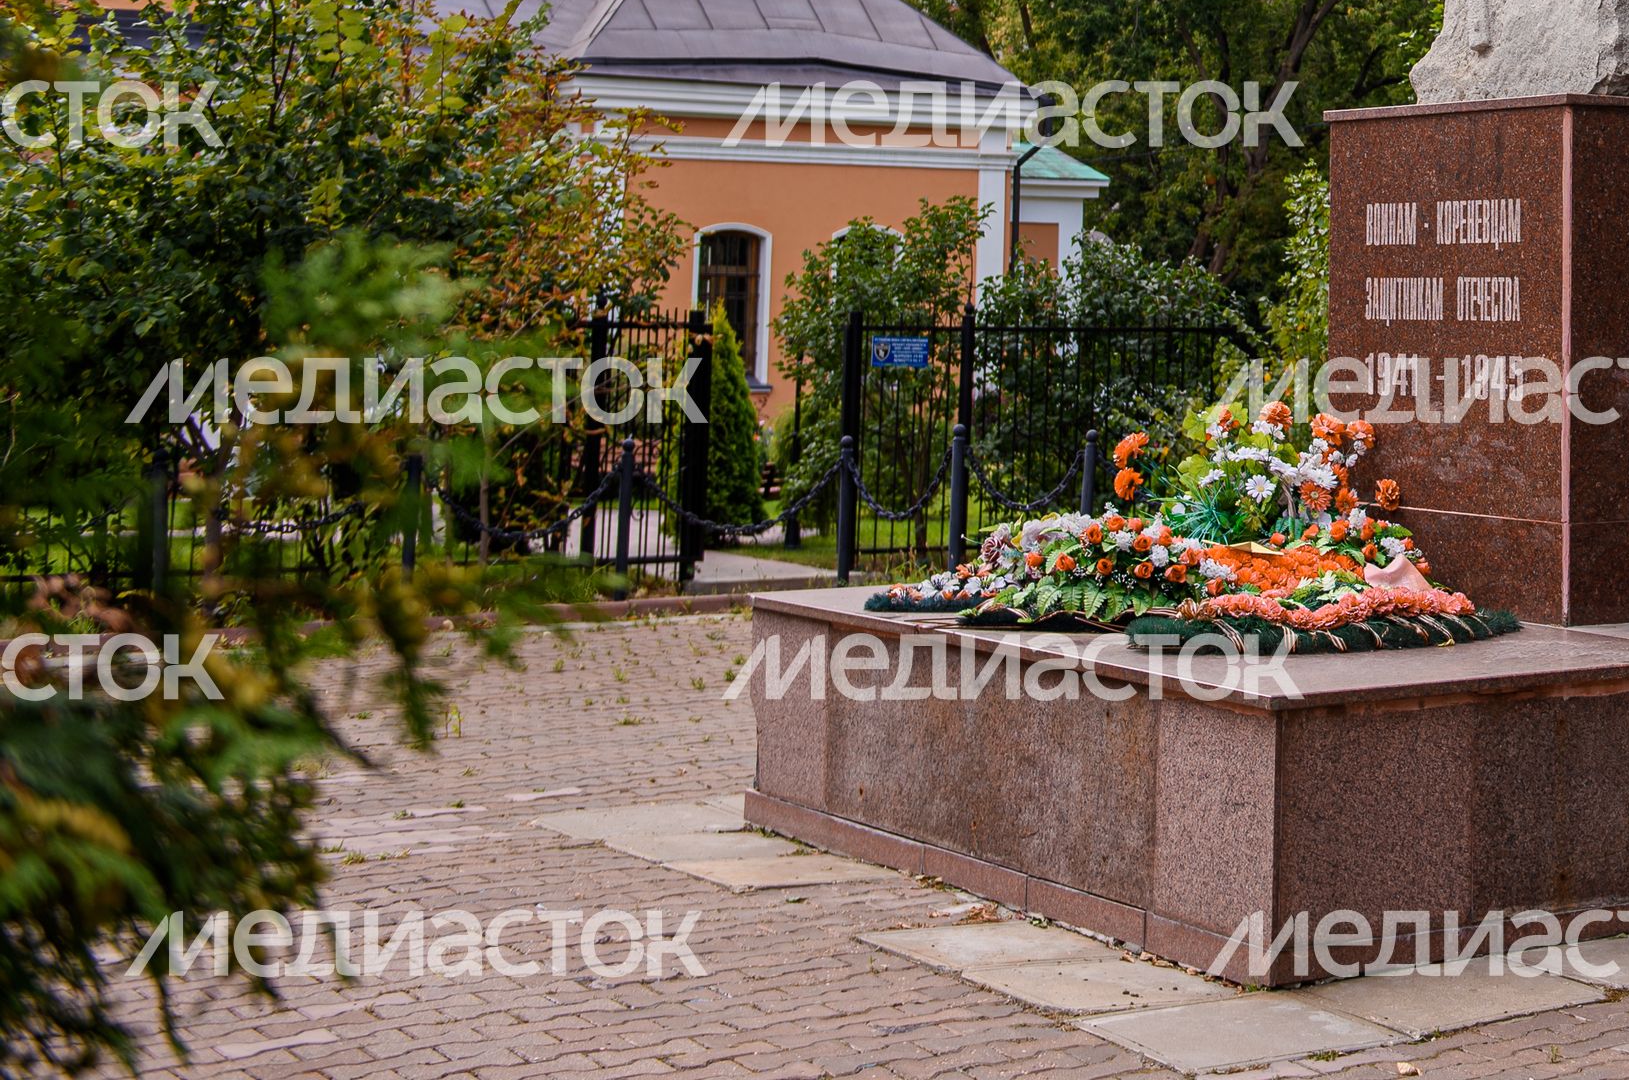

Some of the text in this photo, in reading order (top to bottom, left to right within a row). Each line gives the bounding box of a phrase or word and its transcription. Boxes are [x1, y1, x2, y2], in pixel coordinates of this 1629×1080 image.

[1365, 202, 1417, 246] ВОИНАМ
[1436, 198, 1521, 250] КОРЕНЕВЦАМ
[1365, 276, 1521, 327] ЗАЩИТНИКАМ ОТЕЧЕСТВА
[1365, 352, 1418, 396] 1941
[1461, 354, 1524, 402] 1945
